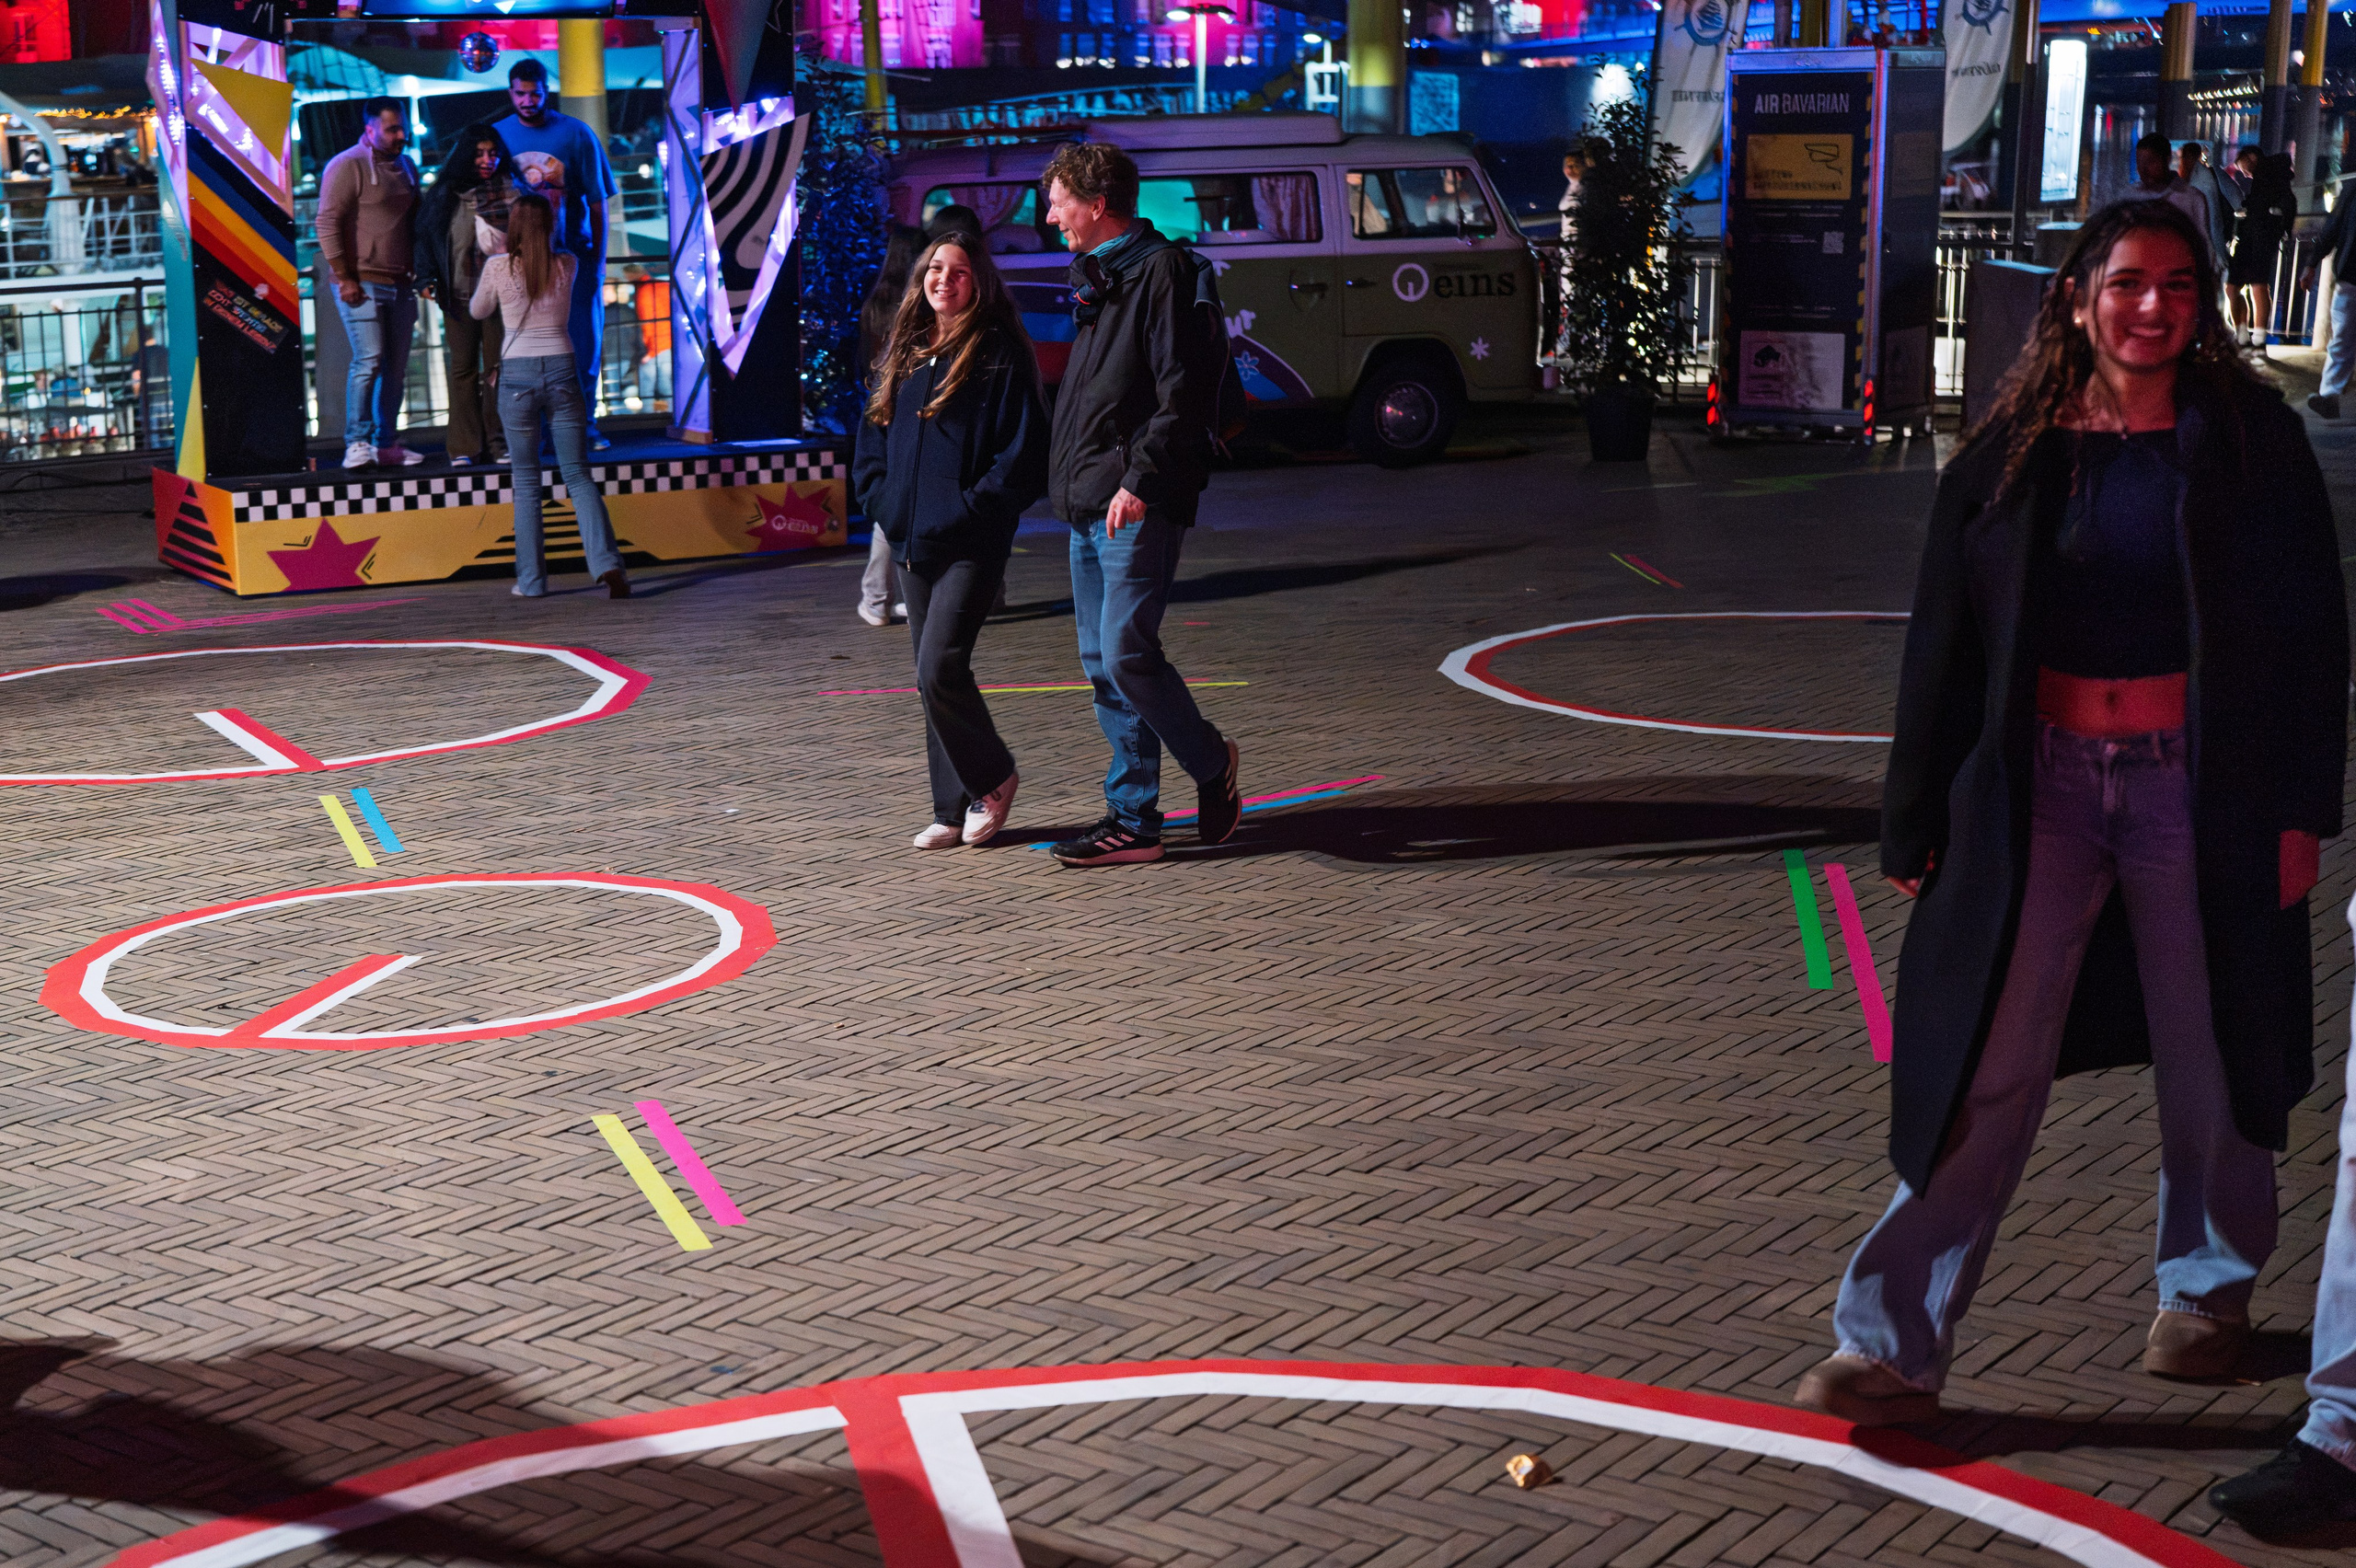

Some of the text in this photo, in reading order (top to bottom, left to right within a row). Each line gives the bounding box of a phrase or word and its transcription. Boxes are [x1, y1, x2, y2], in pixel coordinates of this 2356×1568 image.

[1754, 92, 1851, 115] AIR BAVARIAN
[1433, 271, 1517, 298] eins
